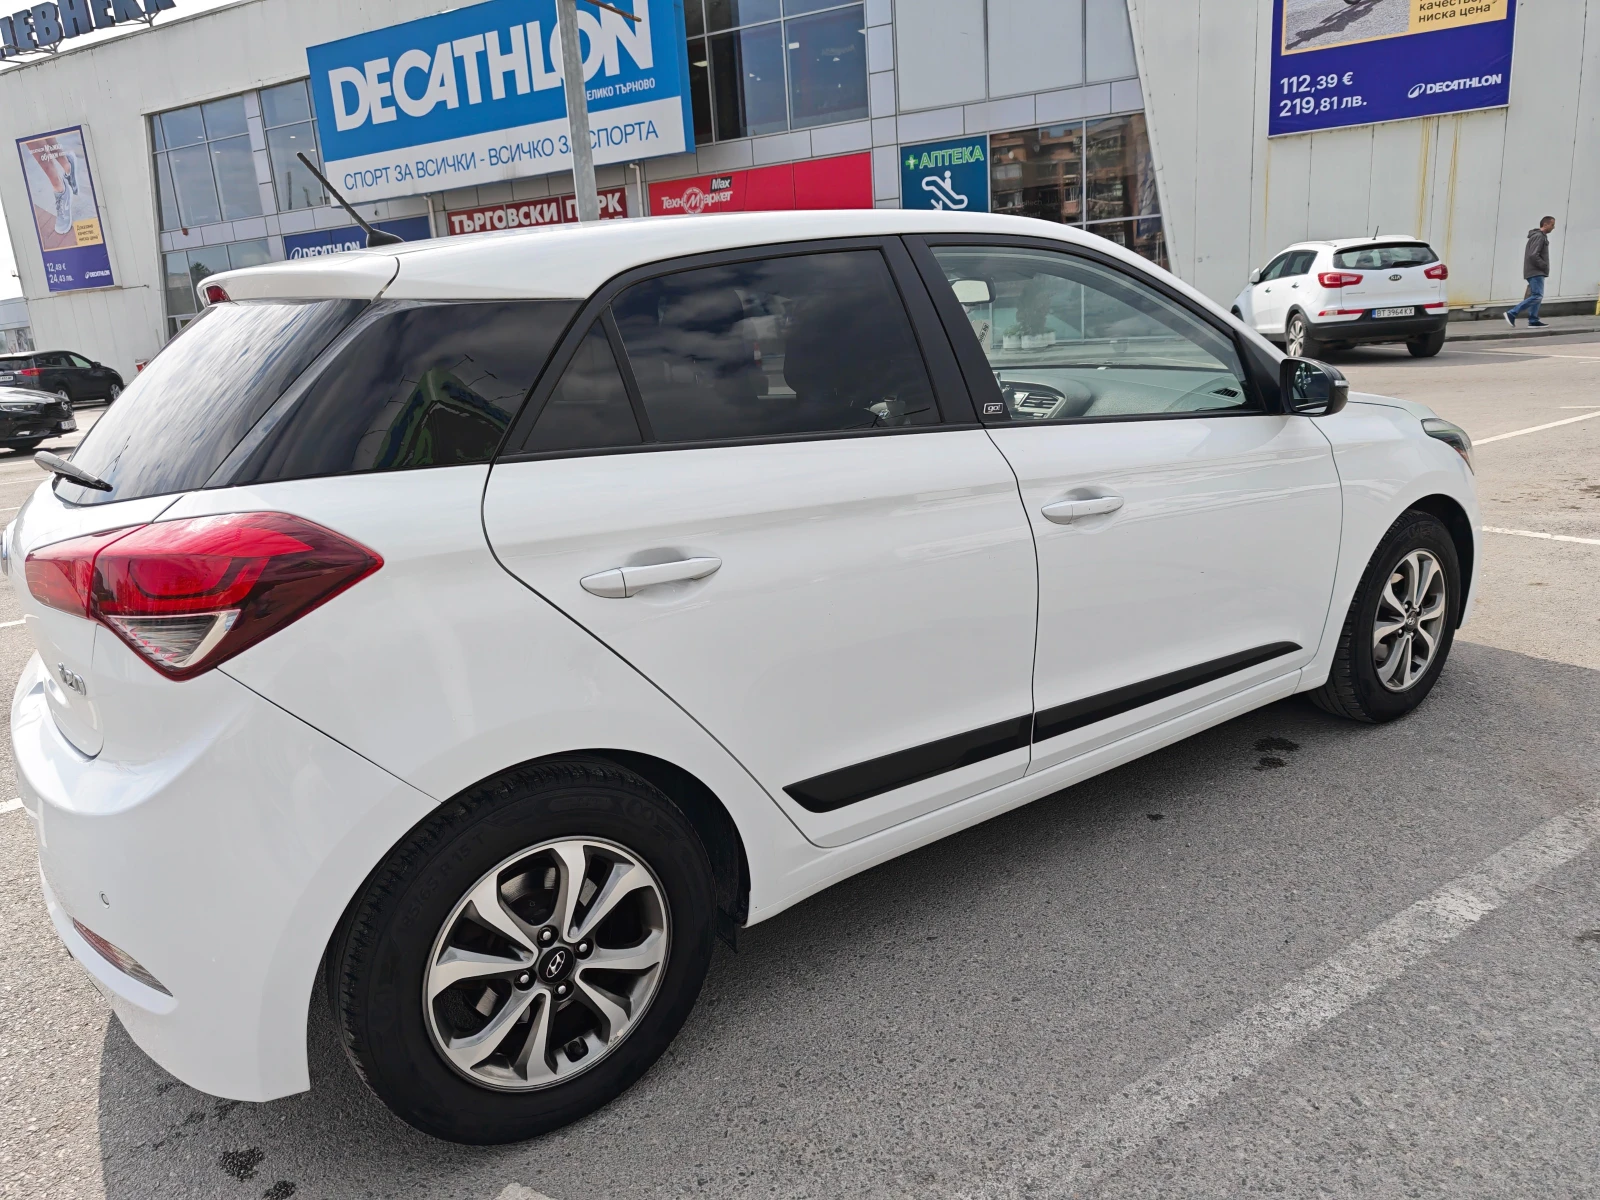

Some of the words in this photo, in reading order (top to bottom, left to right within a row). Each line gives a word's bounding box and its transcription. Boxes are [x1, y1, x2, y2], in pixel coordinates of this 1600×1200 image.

[1418, 9, 1456, 23] ниска
[0, 0, 176, 59] IEBHER
[328, 0, 654, 132] DECATHLON
[586, 86, 614, 101] ЕЛИКО
[615, 77, 656, 95] ТЪРНОВО
[1280, 73, 1338, 95] 112,39
[1342, 71, 1353, 85] €
[1426, 73, 1502, 94] DECATHLON
[1279, 96, 1338, 117] 219,81
[1340, 95, 1367, 109] лв.
[344, 166, 391, 190] СПОРТ
[394, 163, 414, 182] ЗА
[415, 152, 477, 179] ВСИЧКИ
[488, 138, 554, 166] ВСИЧКО
[558, 135, 572, 154] З
[919, 145, 985, 169] АПТЕКА
[711, 178, 731, 190] Max
[451, 202, 559, 234] ТЪРГОВСКИ
[565, 192, 623, 219] ПРК
